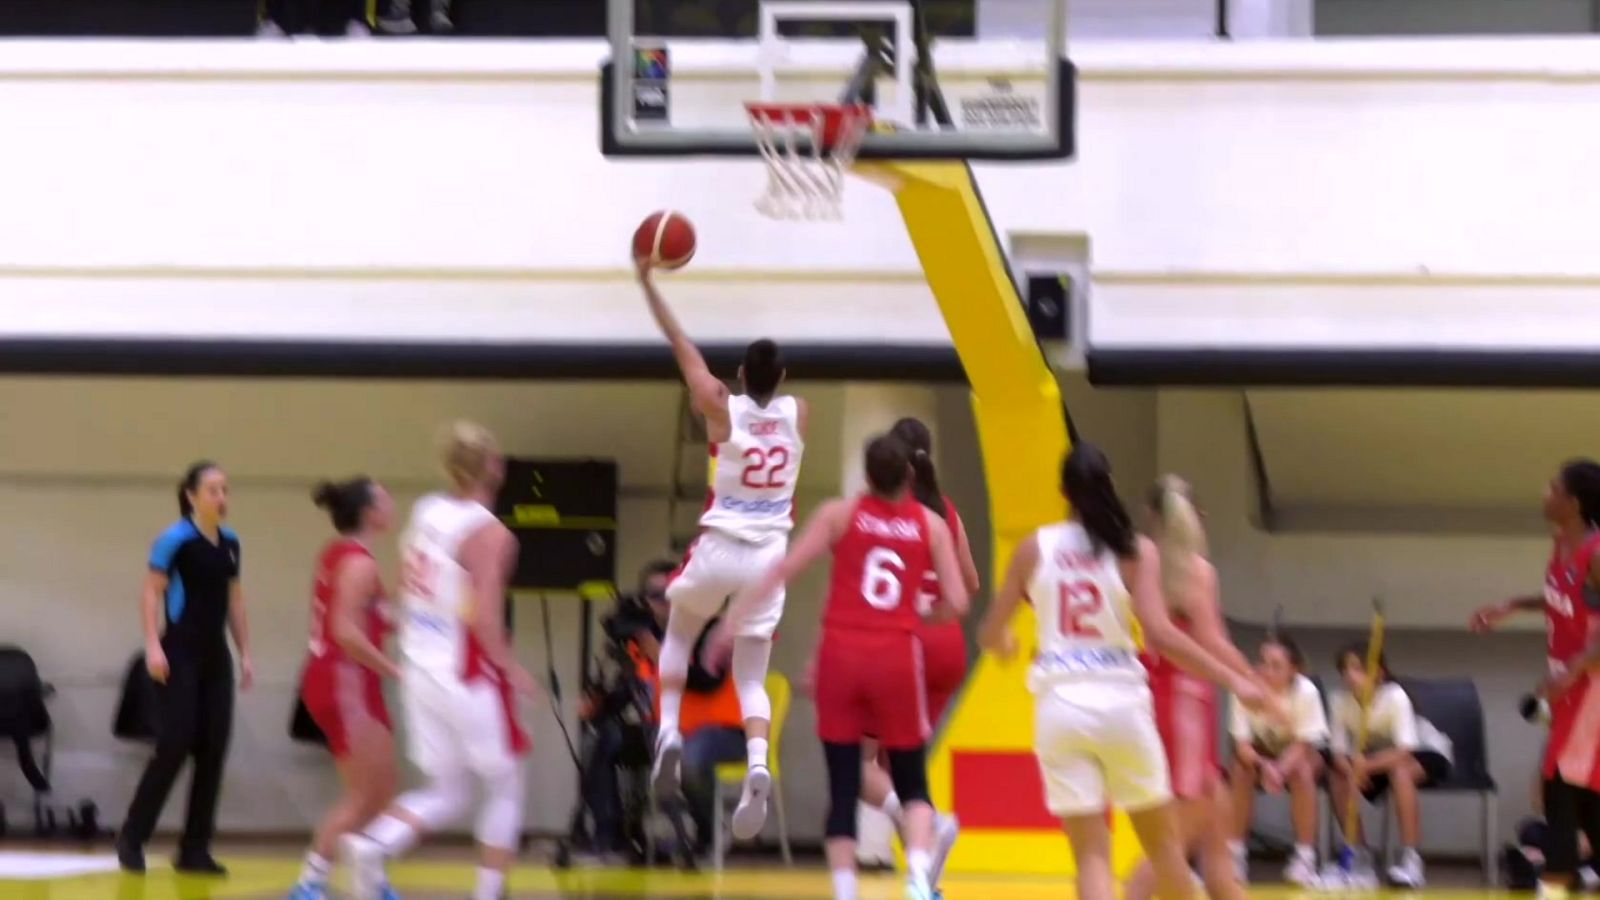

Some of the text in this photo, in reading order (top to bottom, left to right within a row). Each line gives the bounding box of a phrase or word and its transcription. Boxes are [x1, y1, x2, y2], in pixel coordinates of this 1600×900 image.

[741, 446, 789, 489] 22
[861, 546, 906, 612] 6
[1058, 580, 1103, 639] 12
